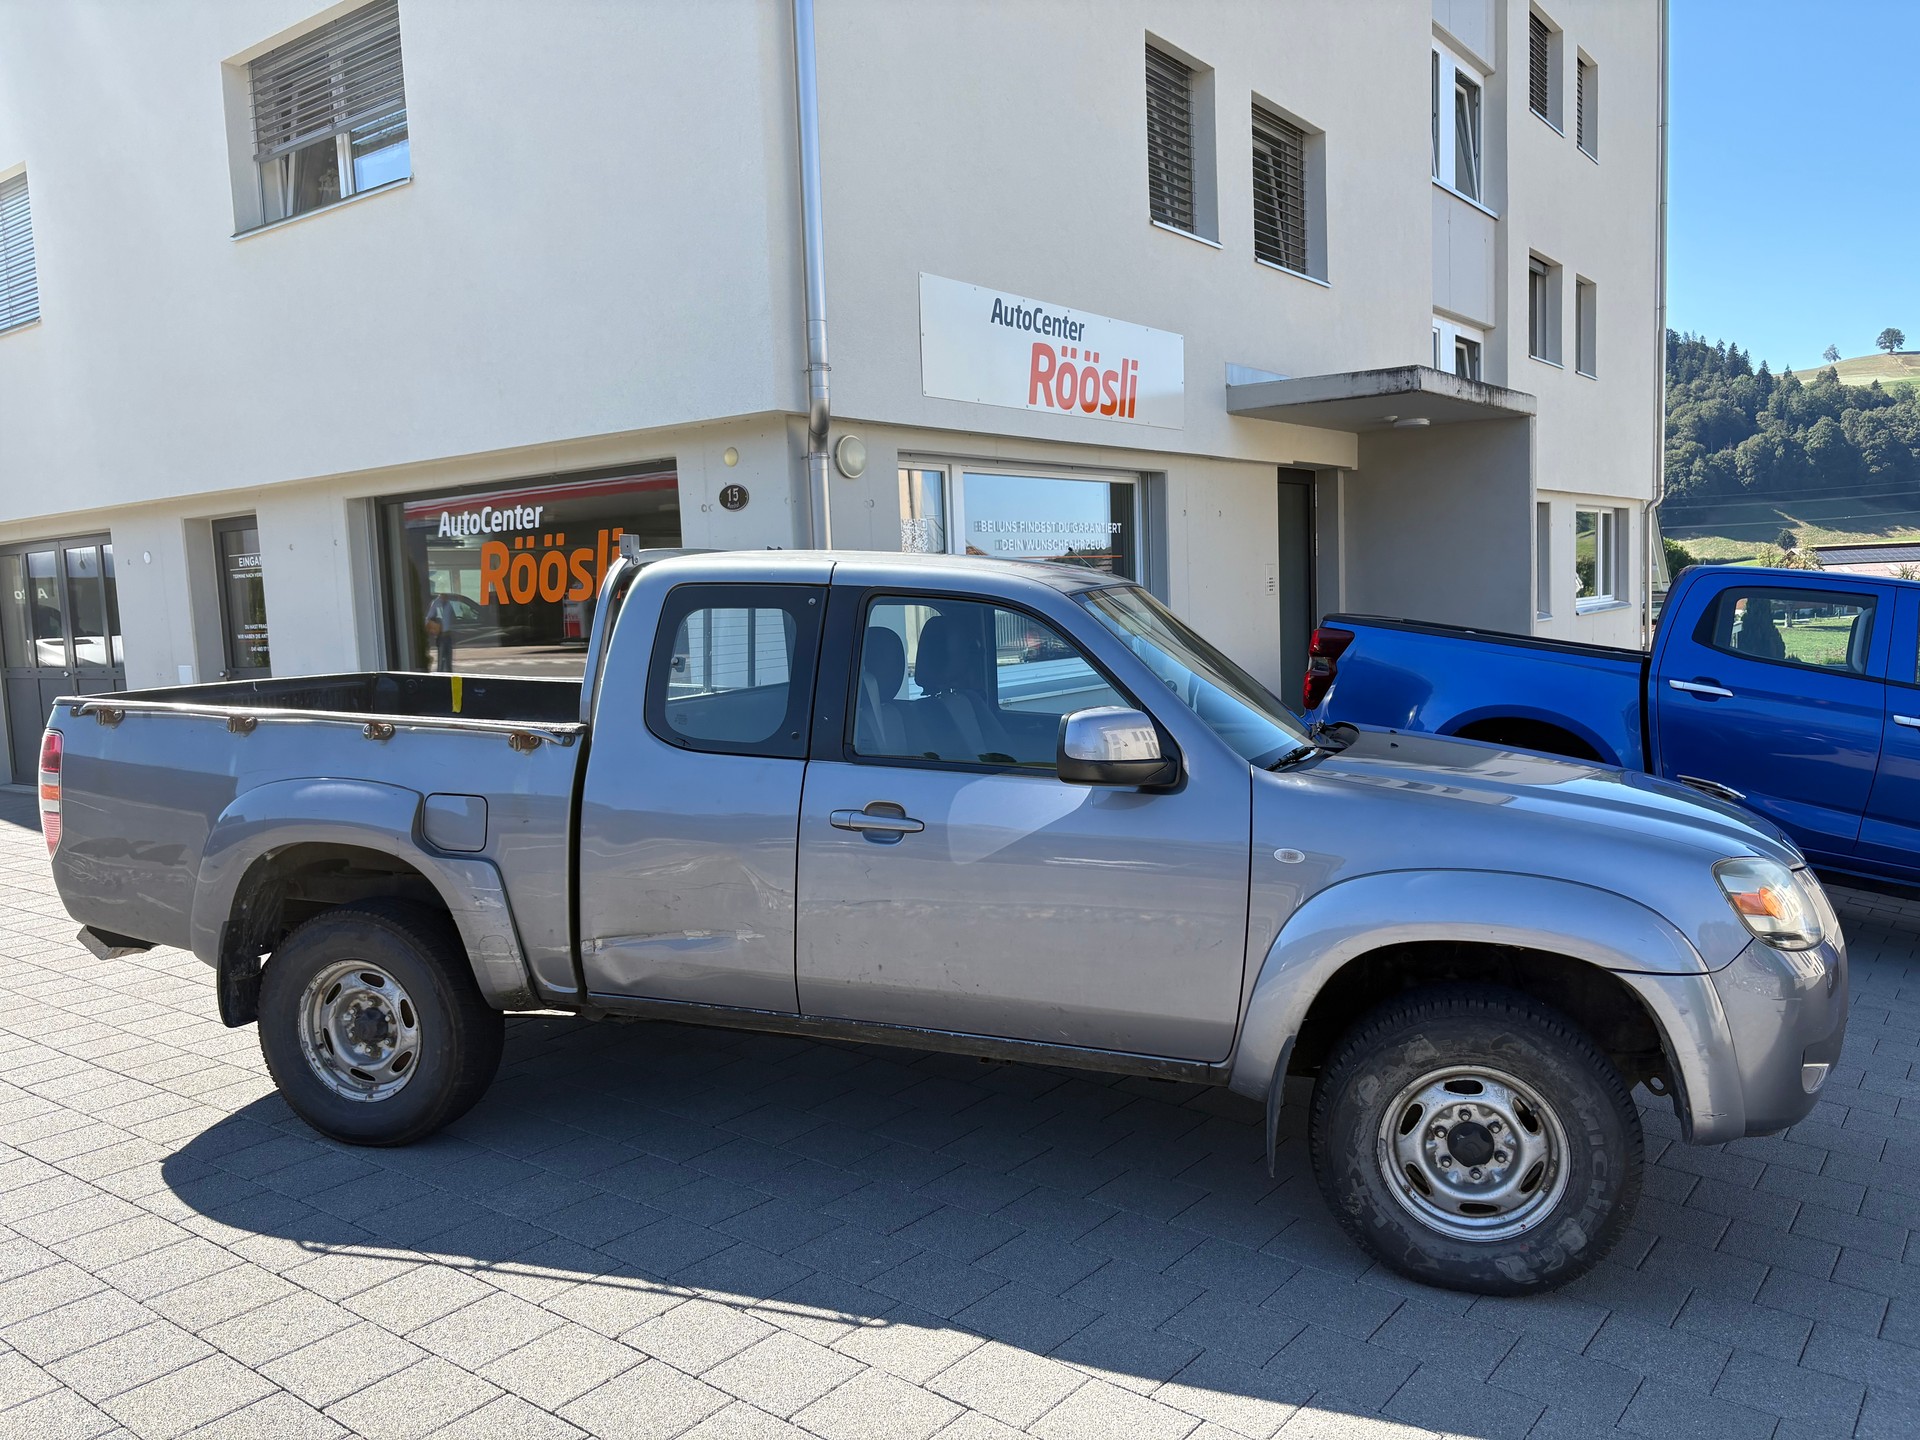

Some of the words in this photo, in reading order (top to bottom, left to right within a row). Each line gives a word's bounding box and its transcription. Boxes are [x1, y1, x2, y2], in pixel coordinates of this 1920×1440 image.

[990, 297, 1085, 342] AutoCenter
[1028, 342, 1138, 419] Röösli
[727, 487, 739, 502] 15
[438, 504, 544, 538] AutoCenter
[981, 520, 996, 532] BEI
[999, 521, 1017, 532] UNS
[1020, 521, 1056, 533] FINDEST
[1058, 521, 1070, 533] DU
[1072, 522, 1122, 534] GARANTIERT
[1002, 539, 1024, 551] DEIN
[1025, 539, 1107, 551] WUNSCHFAHRZEUG
[238, 556, 262, 568] EINGA
